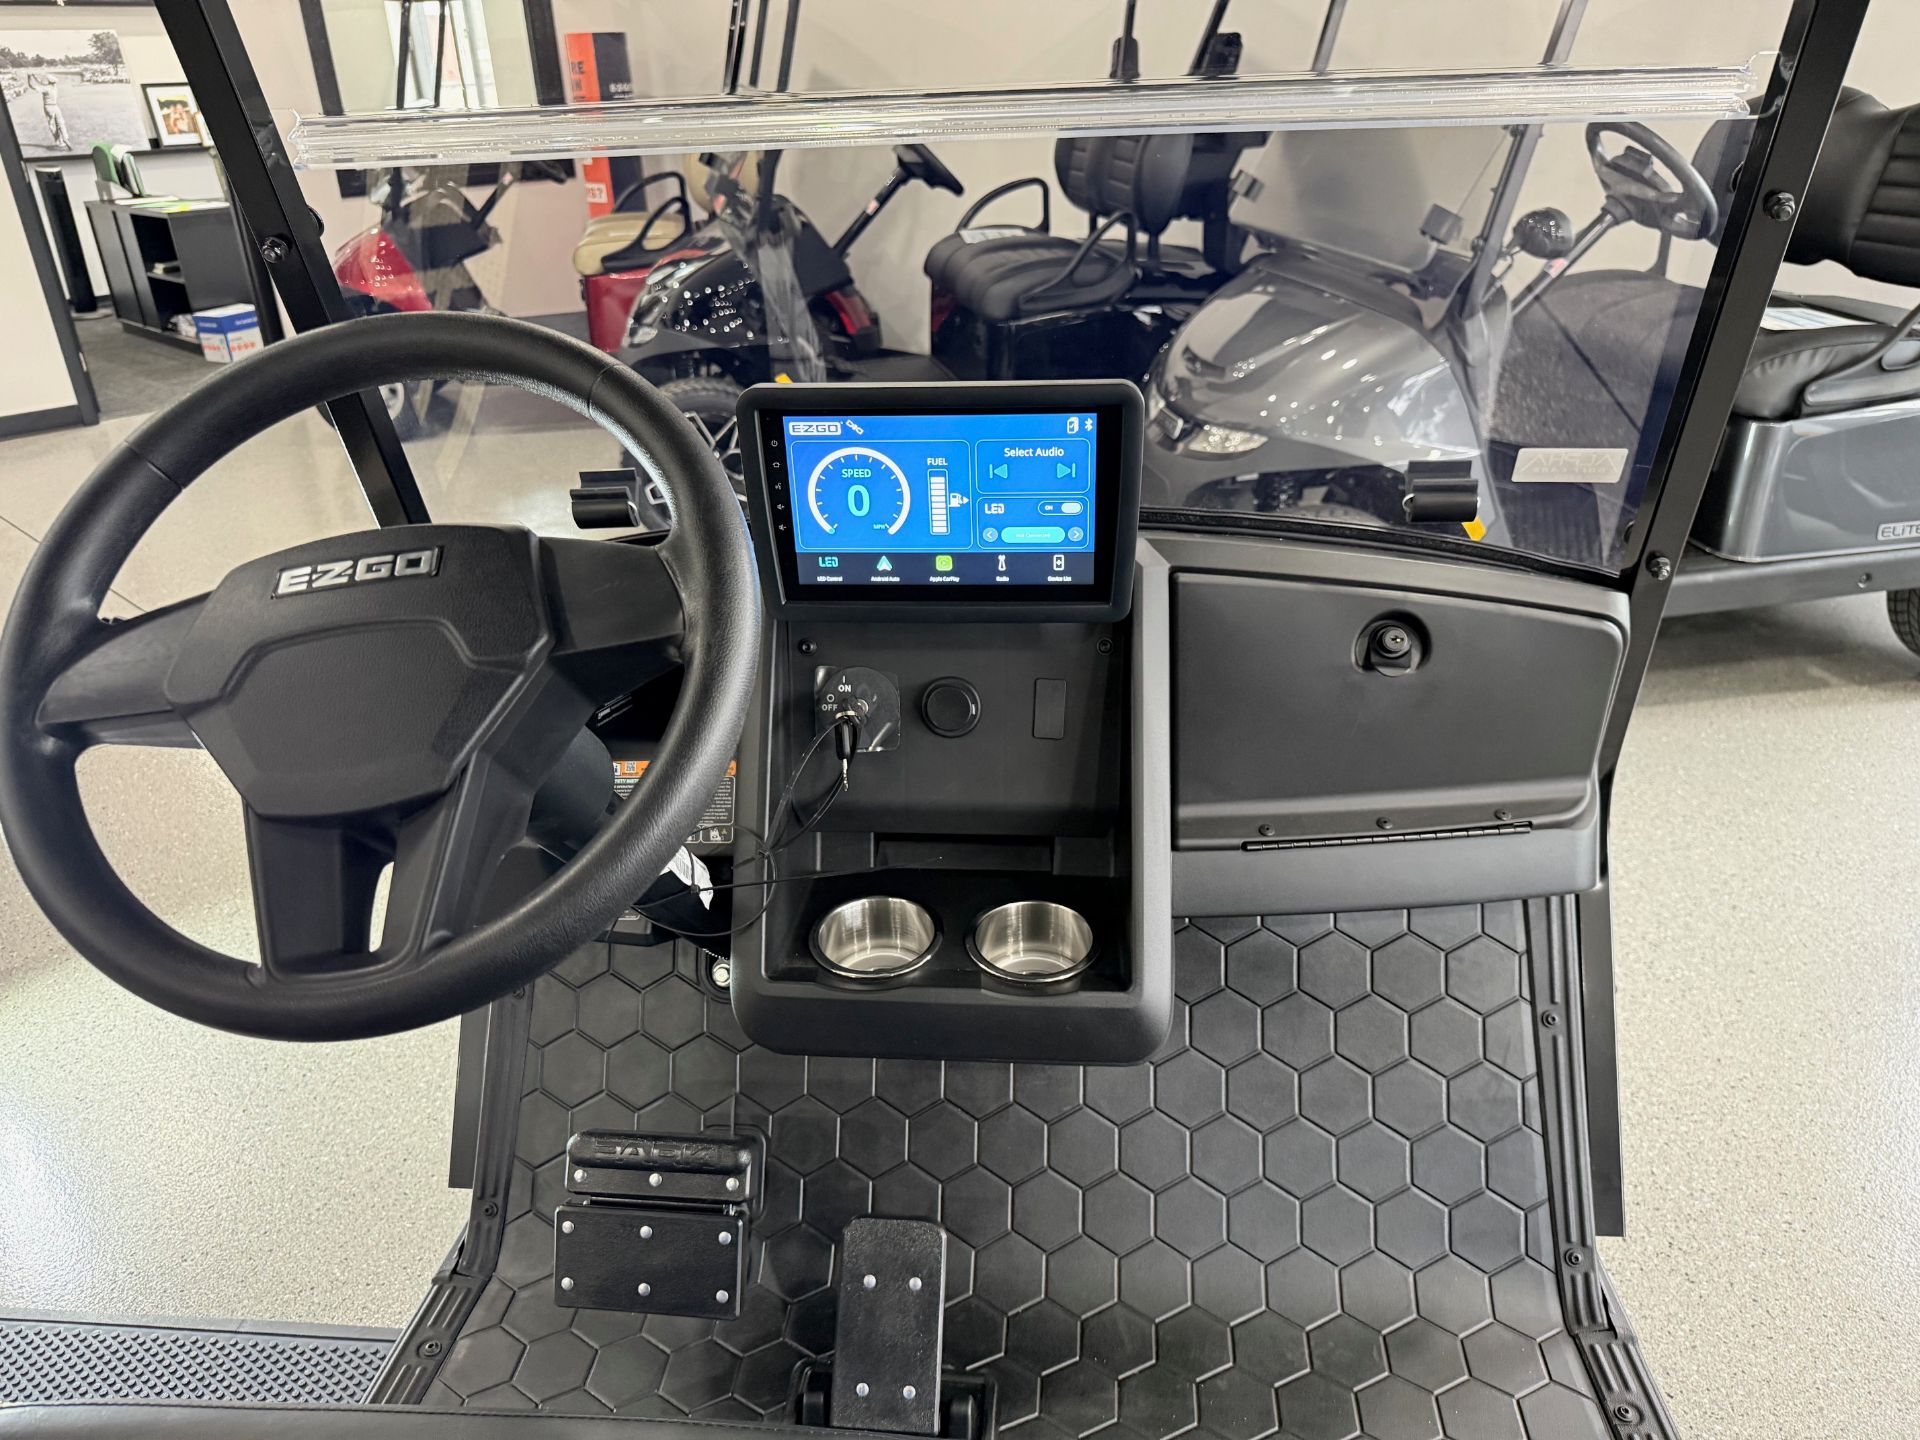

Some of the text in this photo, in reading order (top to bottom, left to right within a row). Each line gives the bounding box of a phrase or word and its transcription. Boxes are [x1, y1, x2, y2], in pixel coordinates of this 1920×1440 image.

[790, 423, 840, 434] EZGO
[1004, 447, 1064, 457] Select Audio
[927, 457, 949, 466] FUEL
[841, 468, 872, 478] SPEED
[847, 484, 870, 517] 0
[984, 503, 1005, 515] LED
[818, 556, 839, 568] LED
[838, 684, 852, 693] ON
[821, 703, 838, 711] OFF
